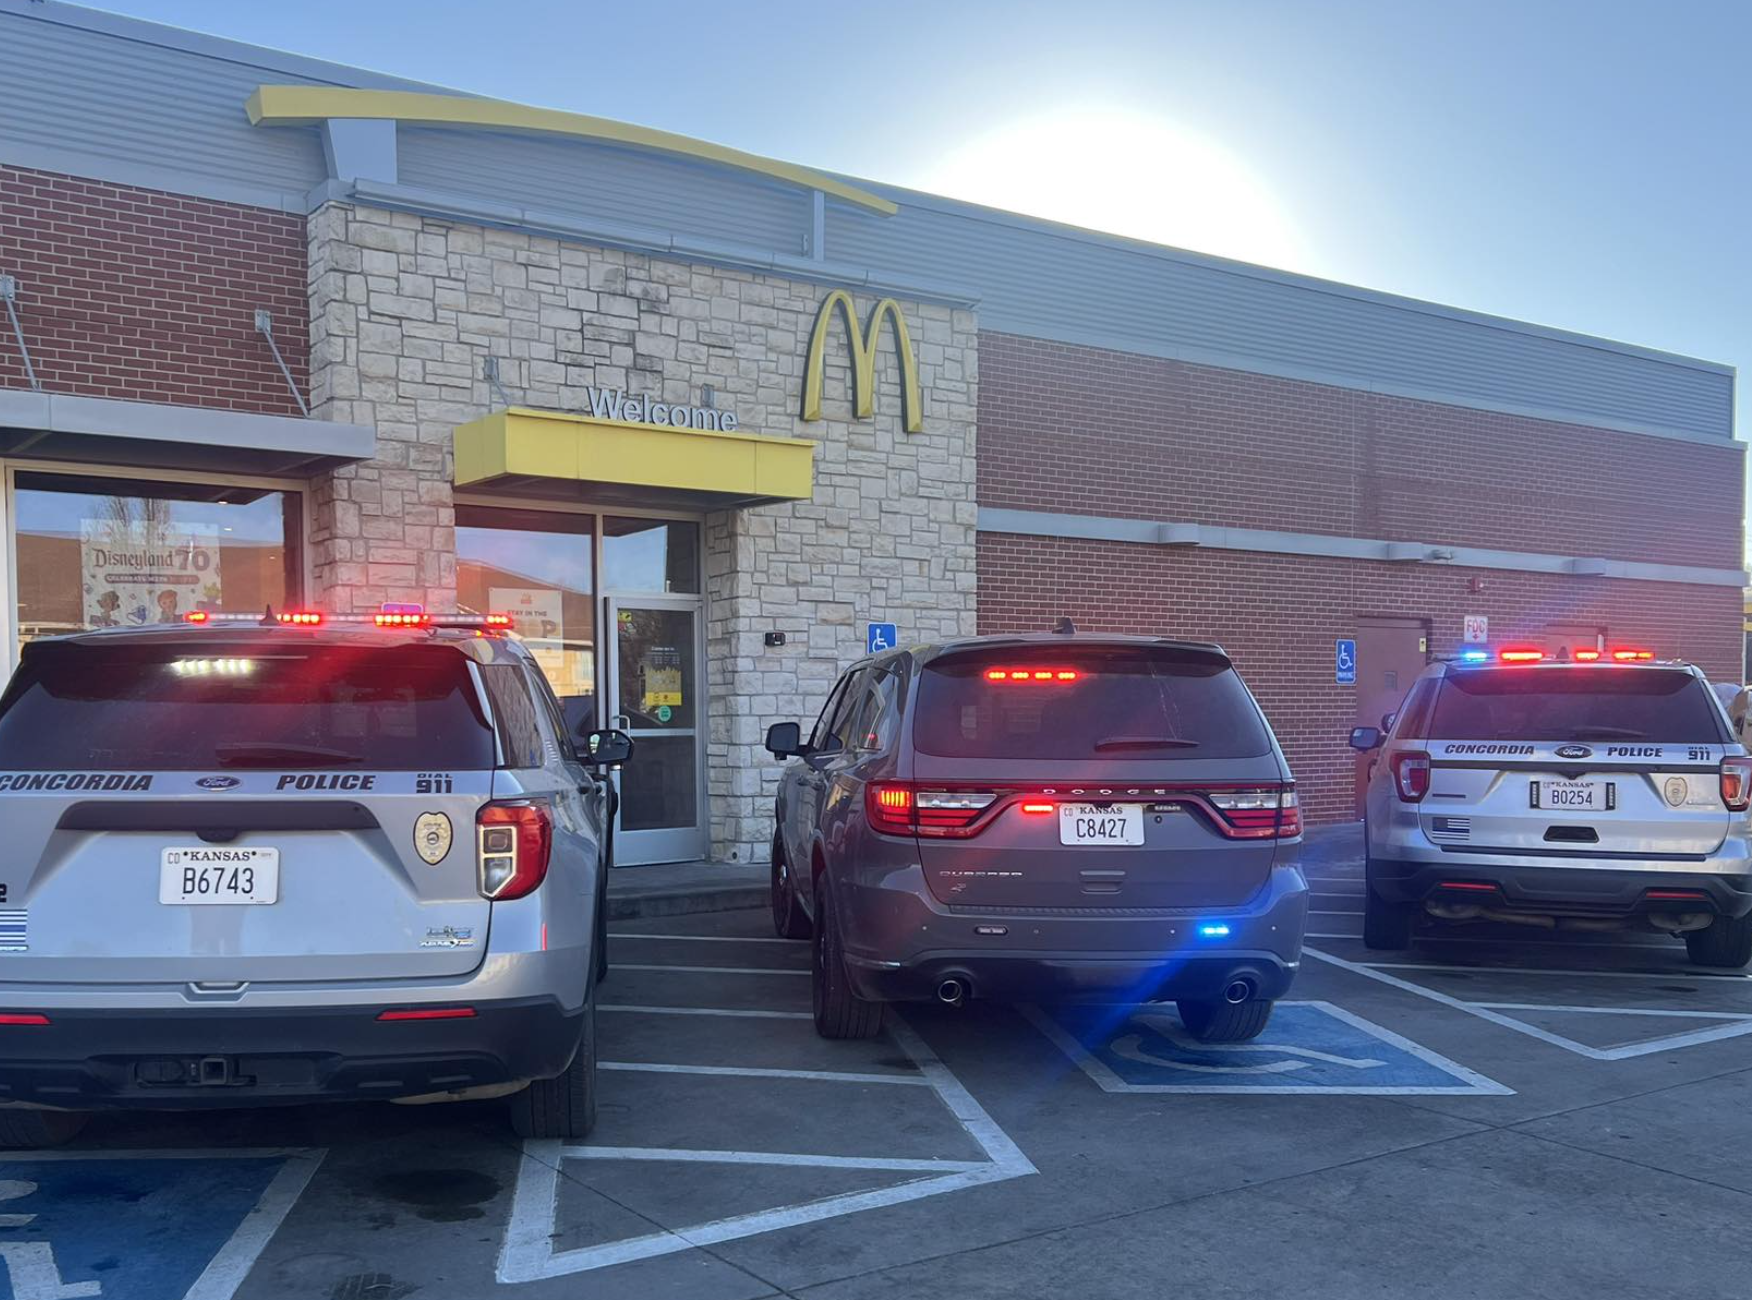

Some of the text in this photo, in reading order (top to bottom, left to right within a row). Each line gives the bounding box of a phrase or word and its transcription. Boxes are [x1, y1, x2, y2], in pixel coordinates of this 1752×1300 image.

[587, 386, 739, 432] Welcome
[92, 548, 210, 571] Disneyland 70
[1466, 618, 1487, 634] FDC
[1444, 744, 1534, 755] CONCORDIA
[1562, 745, 1585, 756] Ford
[1607, 746, 1663, 757] POLICE
[1688, 750, 1710, 760] 911
[0, 774, 153, 791] CONCORDIA
[203, 778, 230, 786] Ford
[276, 774, 376, 790] POLICE
[416, 779, 452, 793] 911
[1551, 789, 1593, 805] B0254
[1079, 806, 1123, 815] KANSAS
[1076, 818, 1127, 838] C8427
[190, 851, 251, 861] KANSAS
[182, 867, 254, 894] B6743
